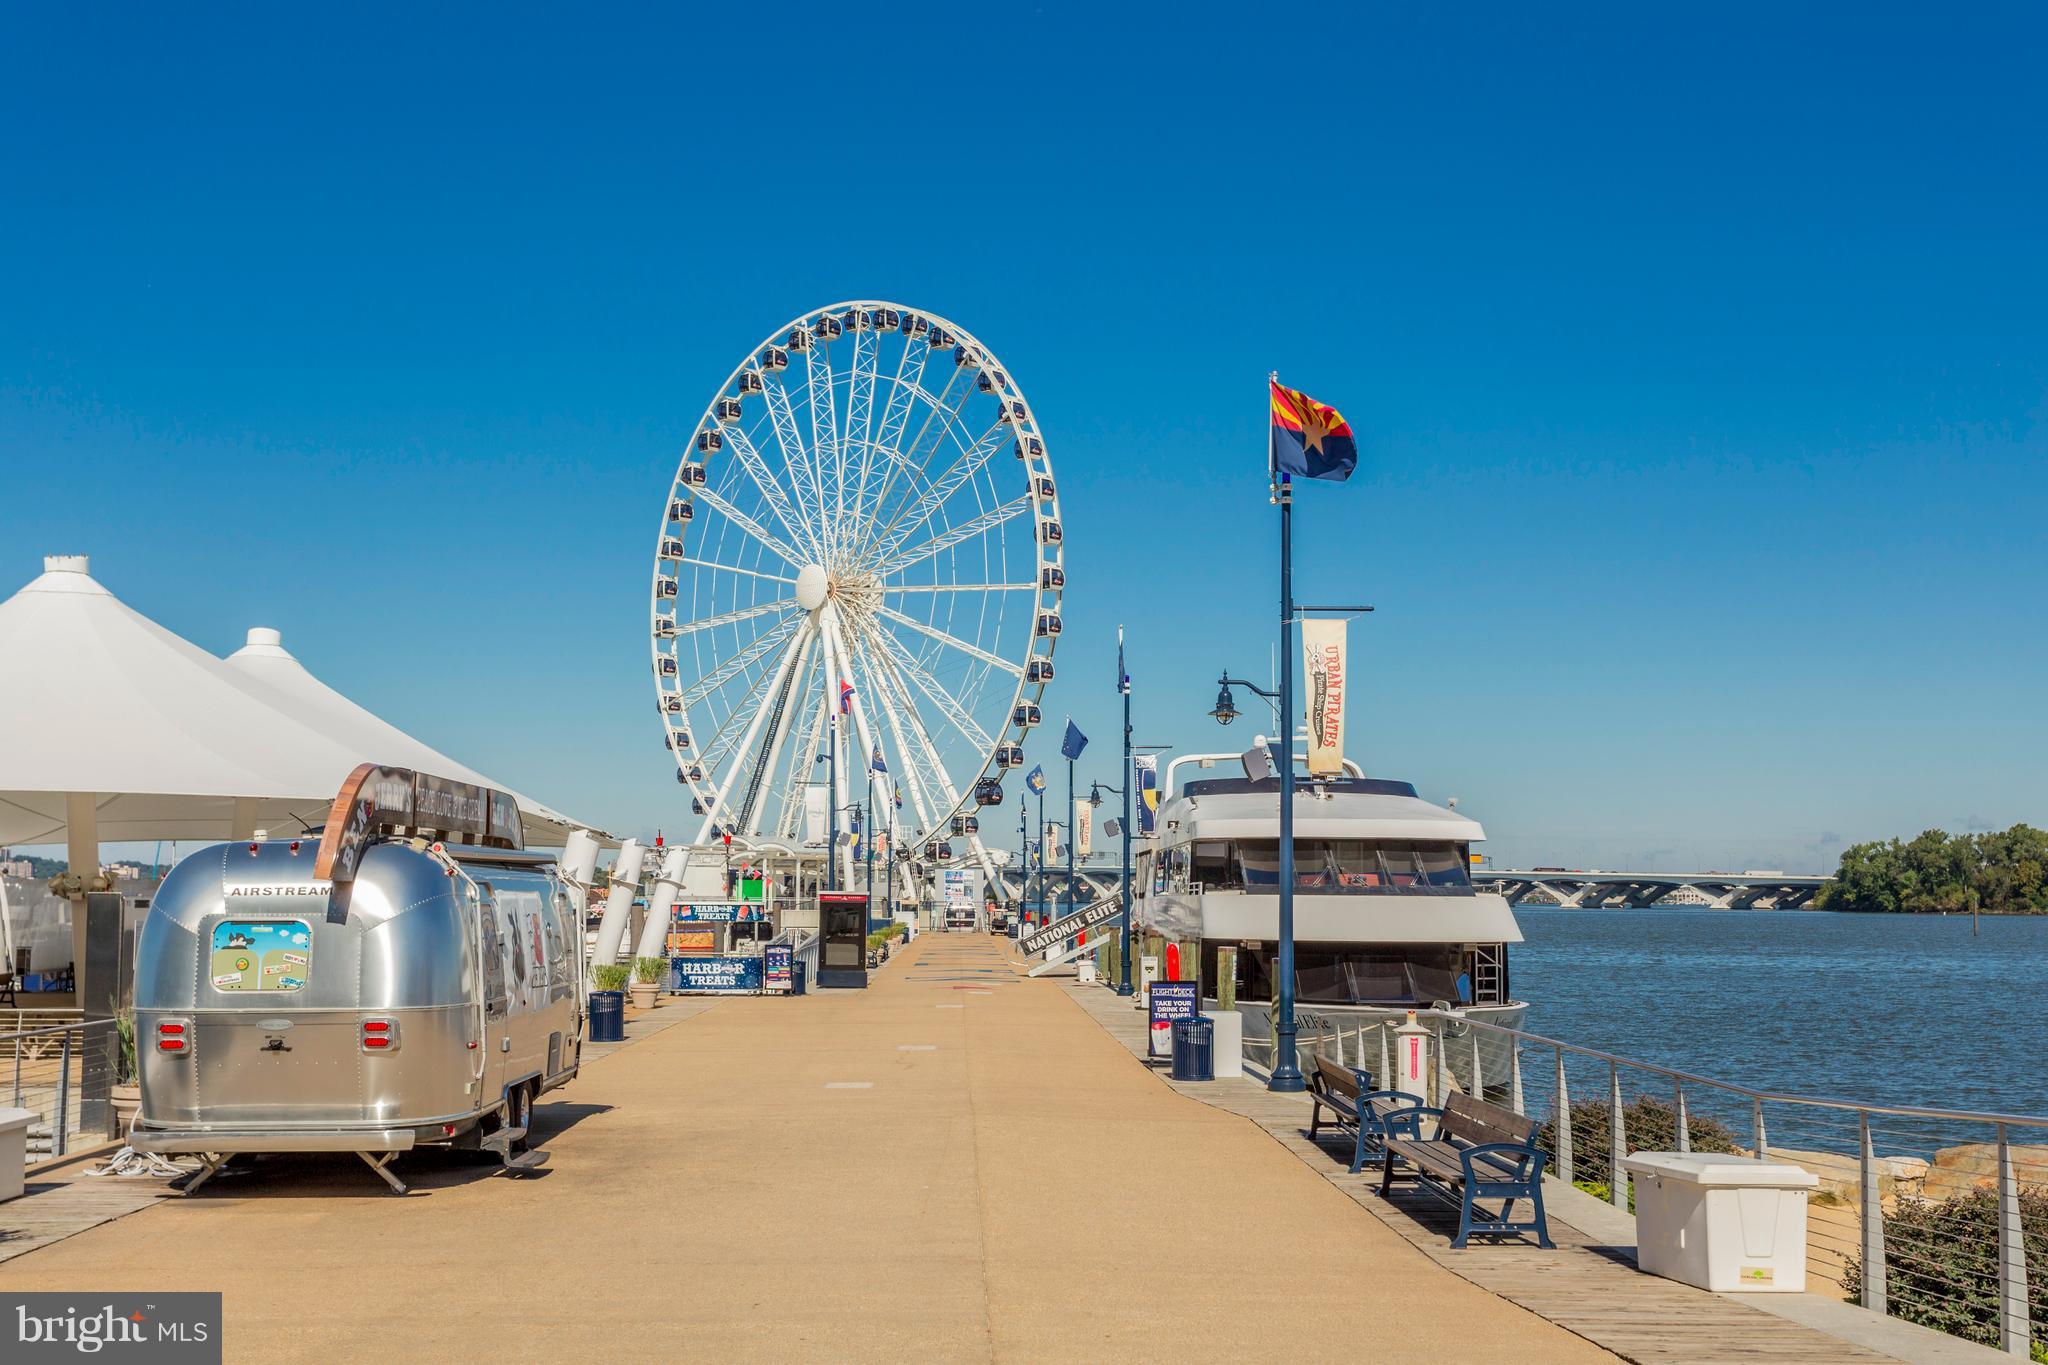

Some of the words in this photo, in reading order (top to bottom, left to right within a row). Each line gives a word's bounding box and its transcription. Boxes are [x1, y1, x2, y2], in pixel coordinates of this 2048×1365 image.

[1324, 645, 1343, 689] URBAN
[1316, 674, 1325, 694] Pirate
[1315, 695, 1325, 710] Ship
[1315, 711, 1323, 735] Cruises
[1323, 691, 1342, 748] PIRATES
[231, 886, 333, 897] AIRSTREAM
[697, 912, 731, 920] TREATS
[1026, 917, 1085, 952] NATIONAL
[1085, 901, 1118, 924] ELITE
[689, 975, 736, 986] TREATS
